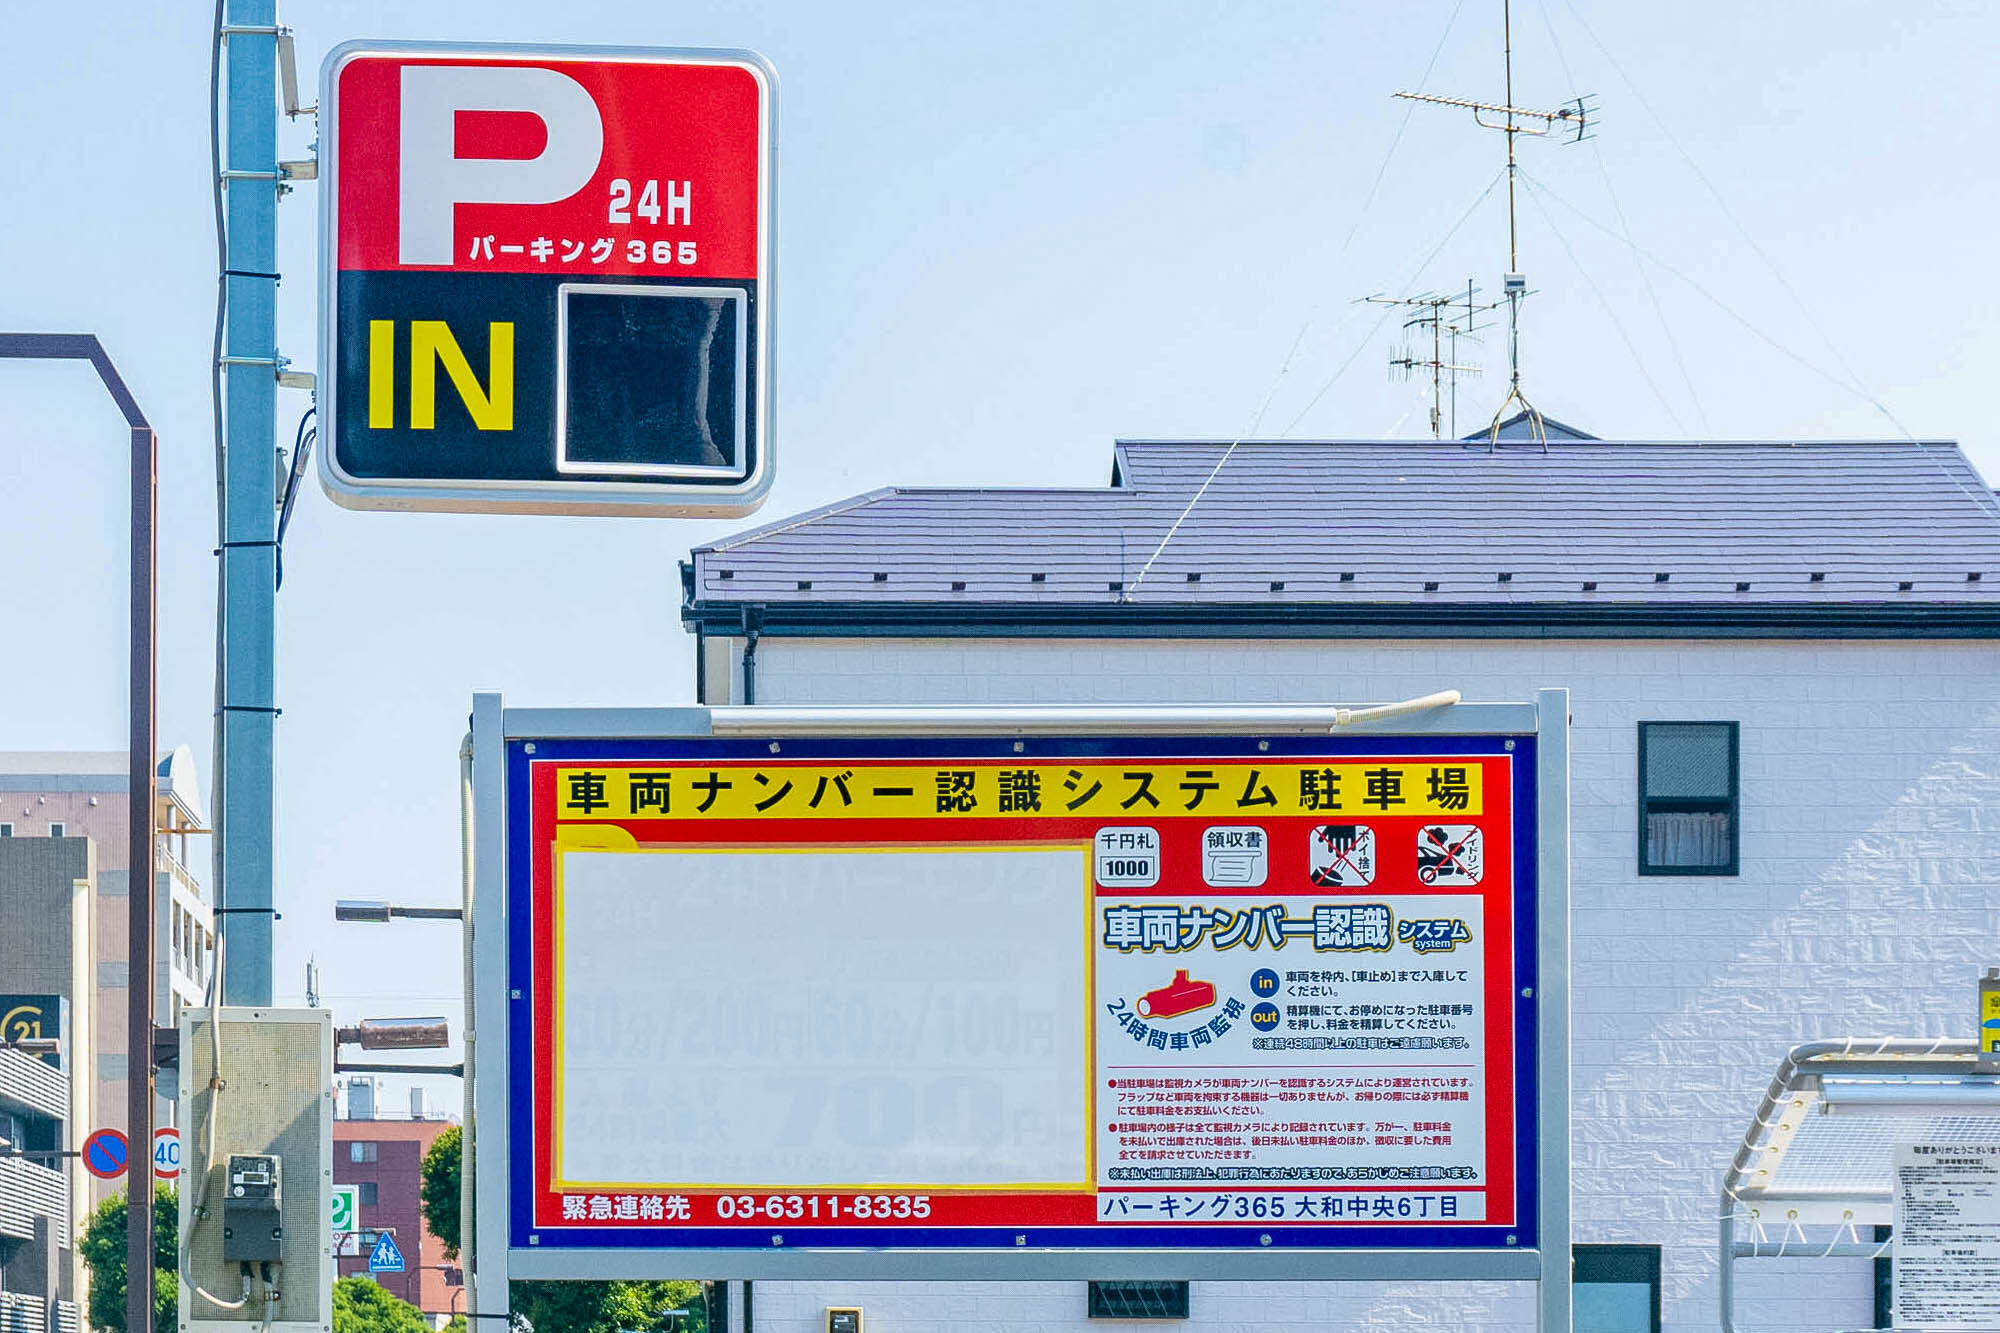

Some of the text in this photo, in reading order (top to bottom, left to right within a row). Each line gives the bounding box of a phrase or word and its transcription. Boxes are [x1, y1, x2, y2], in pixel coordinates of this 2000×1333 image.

[399, 65, 604, 265] P
[608, 179, 691, 226] 24H
[469, 236, 698, 265] パーキング 365
[368, 319, 514, 431] IN
[566, 767, 1471, 815] 車両ナンバー認識システム駐車場
[1101, 832, 1155, 850] 千円札
[1207, 831, 1264, 849] 領収書
[1105, 859, 1149, 877] 1000
[1105, 904, 1469, 950] 車両ナンバー認識 システム
[1414, 939, 1452, 950] system
[1258, 975, 1273, 989] in
[1286, 985, 1339, 998] ください。
[1106, 996, 1246, 1052] 24時間車両監視
[1251, 1009, 1279, 1024] out
[154, 1142, 180, 1164] 40
[562, 1195, 931, 1220] 緊急連絡先 03-6311-8335
[1103, 1193, 1459, 1219] パーキング365 大和中央6丁目
